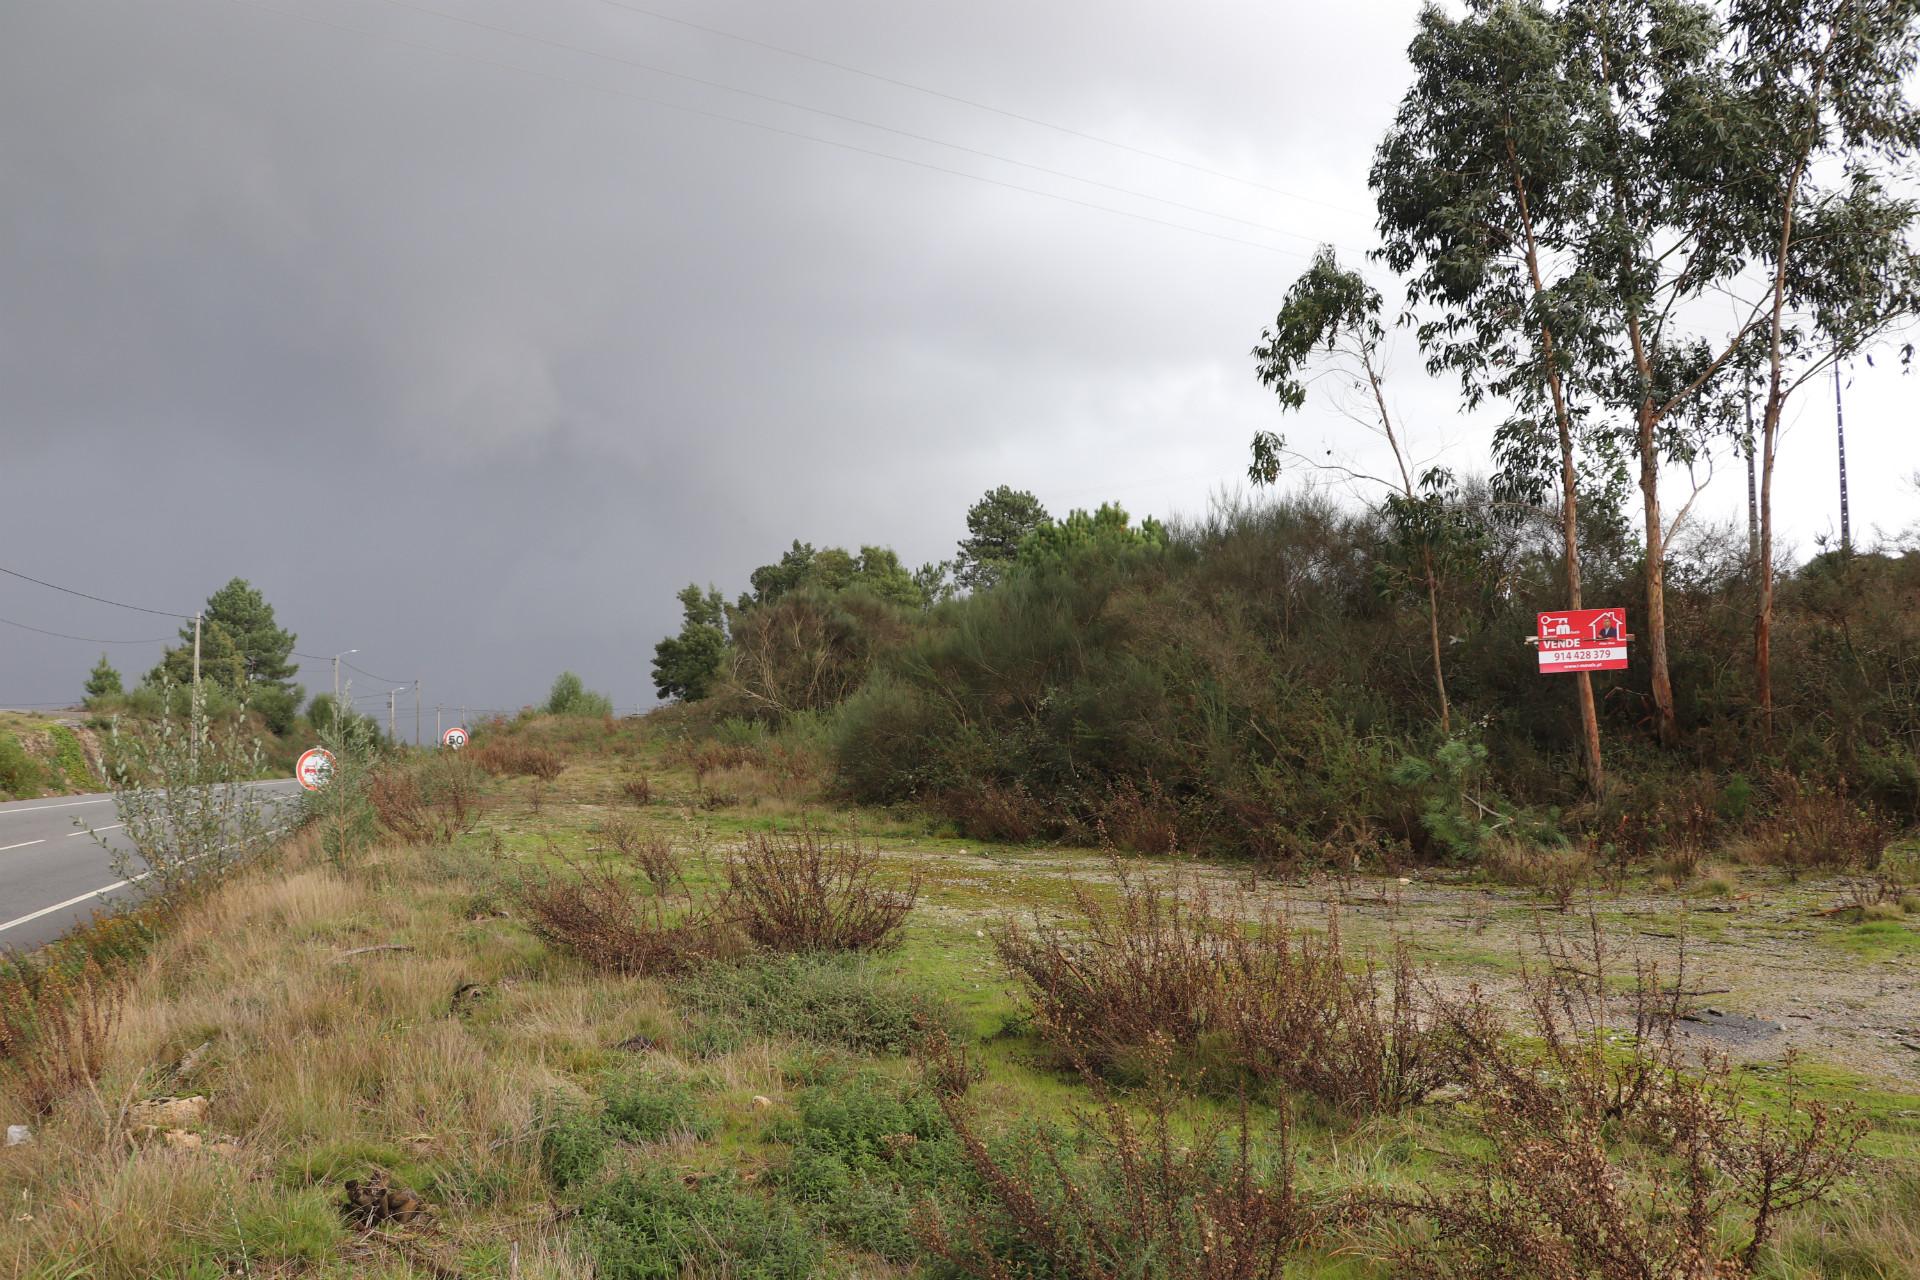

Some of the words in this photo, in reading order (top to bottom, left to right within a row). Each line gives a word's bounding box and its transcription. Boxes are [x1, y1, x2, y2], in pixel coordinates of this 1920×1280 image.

[1543, 639, 1580, 648] VENDE
[1554, 652, 1572, 661] 914
[1574, 651, 1591, 660] 428
[1593, 649, 1611, 659] 379
[448, 736, 464, 744] 50
